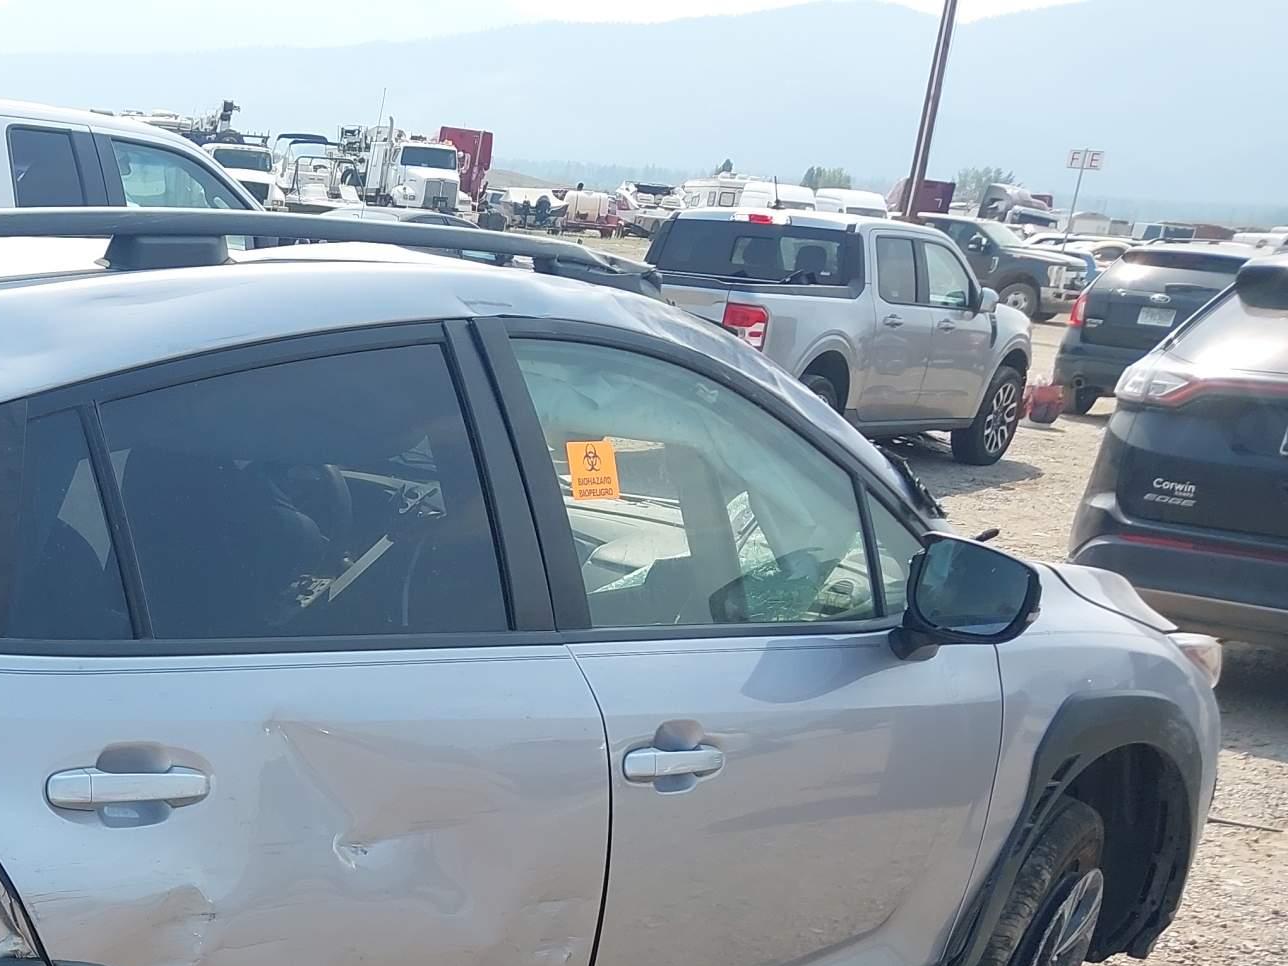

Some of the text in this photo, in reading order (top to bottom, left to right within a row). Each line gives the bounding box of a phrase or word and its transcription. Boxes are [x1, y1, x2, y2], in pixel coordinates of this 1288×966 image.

[1070, 151, 1101, 168] F E
[577, 476, 612, 486] BIOHAZARD
[1153, 478, 1196, 493] Corwin
[578, 488, 614, 498] BIOPELIGRO
